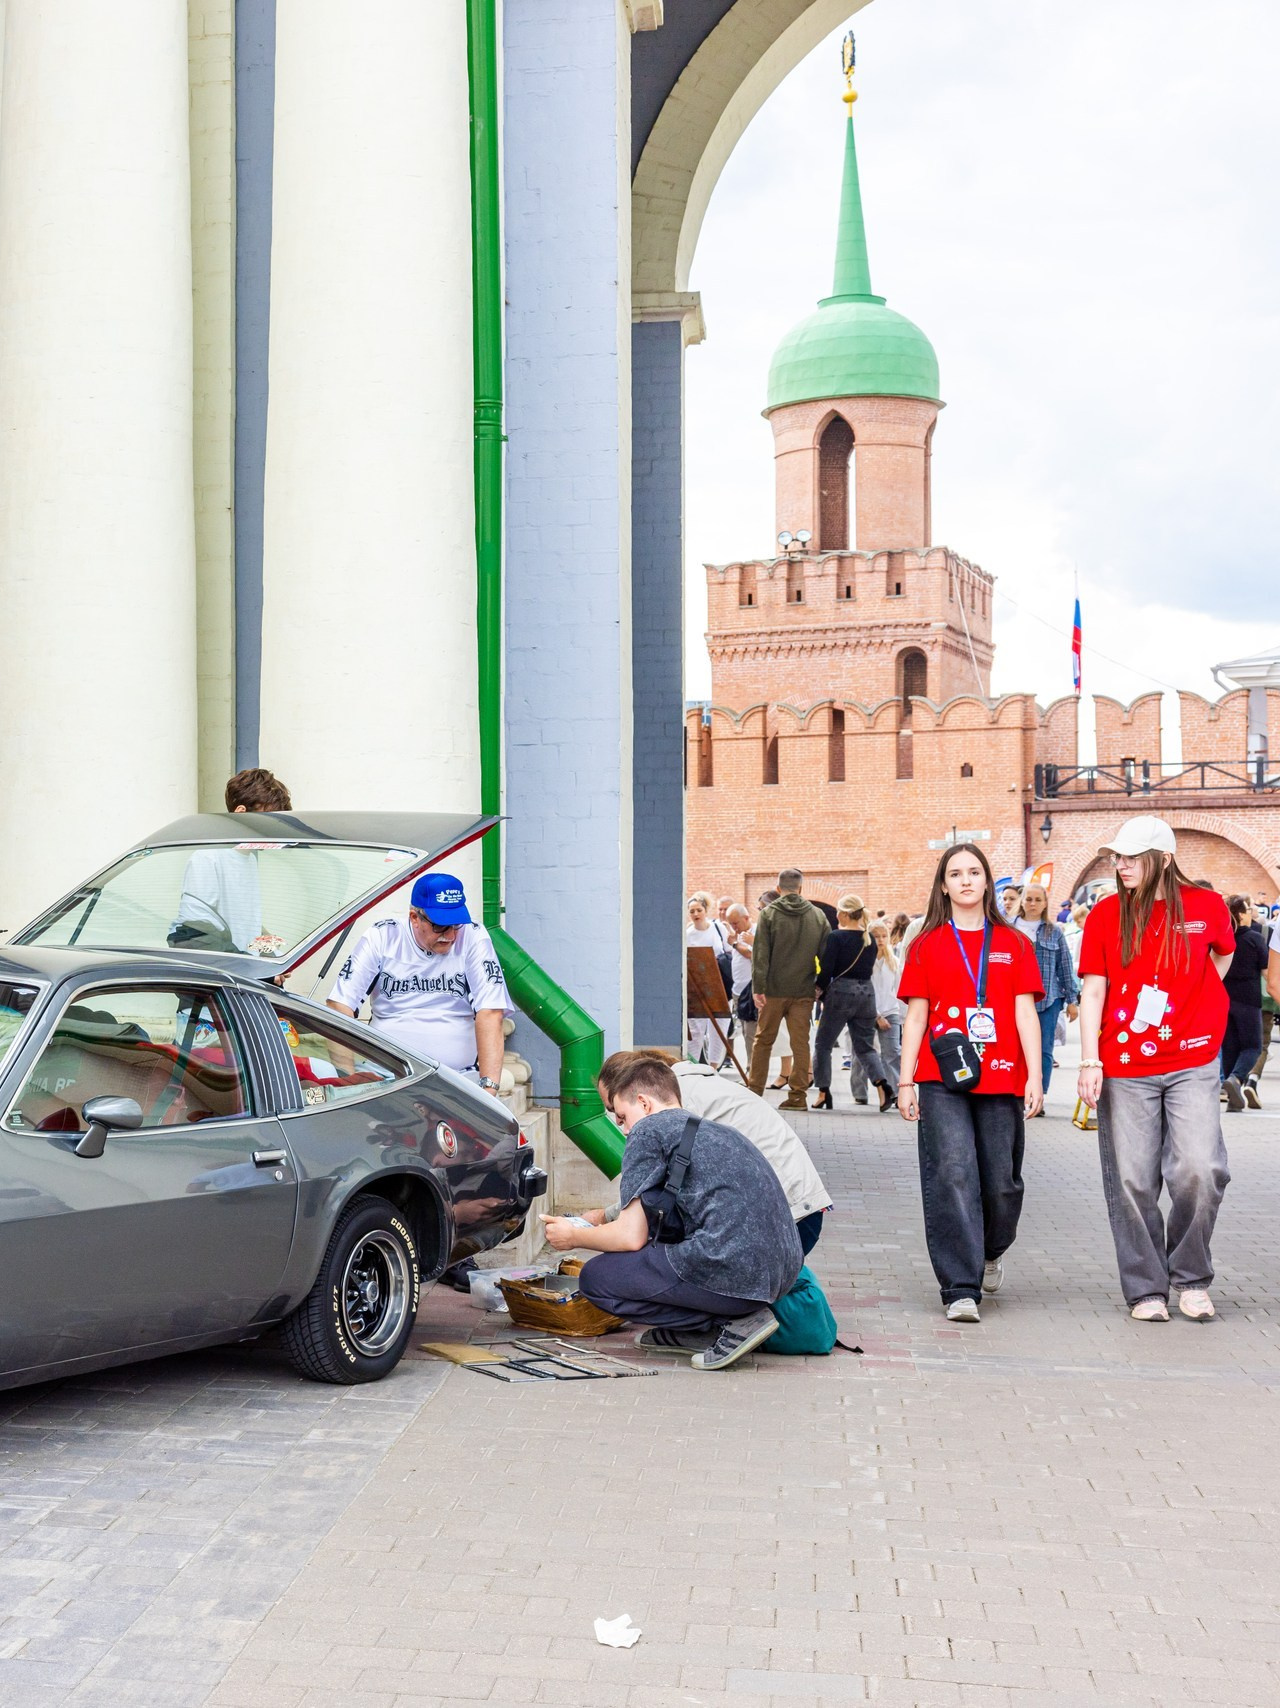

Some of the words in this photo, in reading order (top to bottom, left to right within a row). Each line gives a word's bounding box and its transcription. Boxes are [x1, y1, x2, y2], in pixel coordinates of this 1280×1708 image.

[390, 1217, 416, 1259] COOPER
[411, 1263, 420, 1313] COBRA
[334, 1317, 357, 1364] RADIAL
